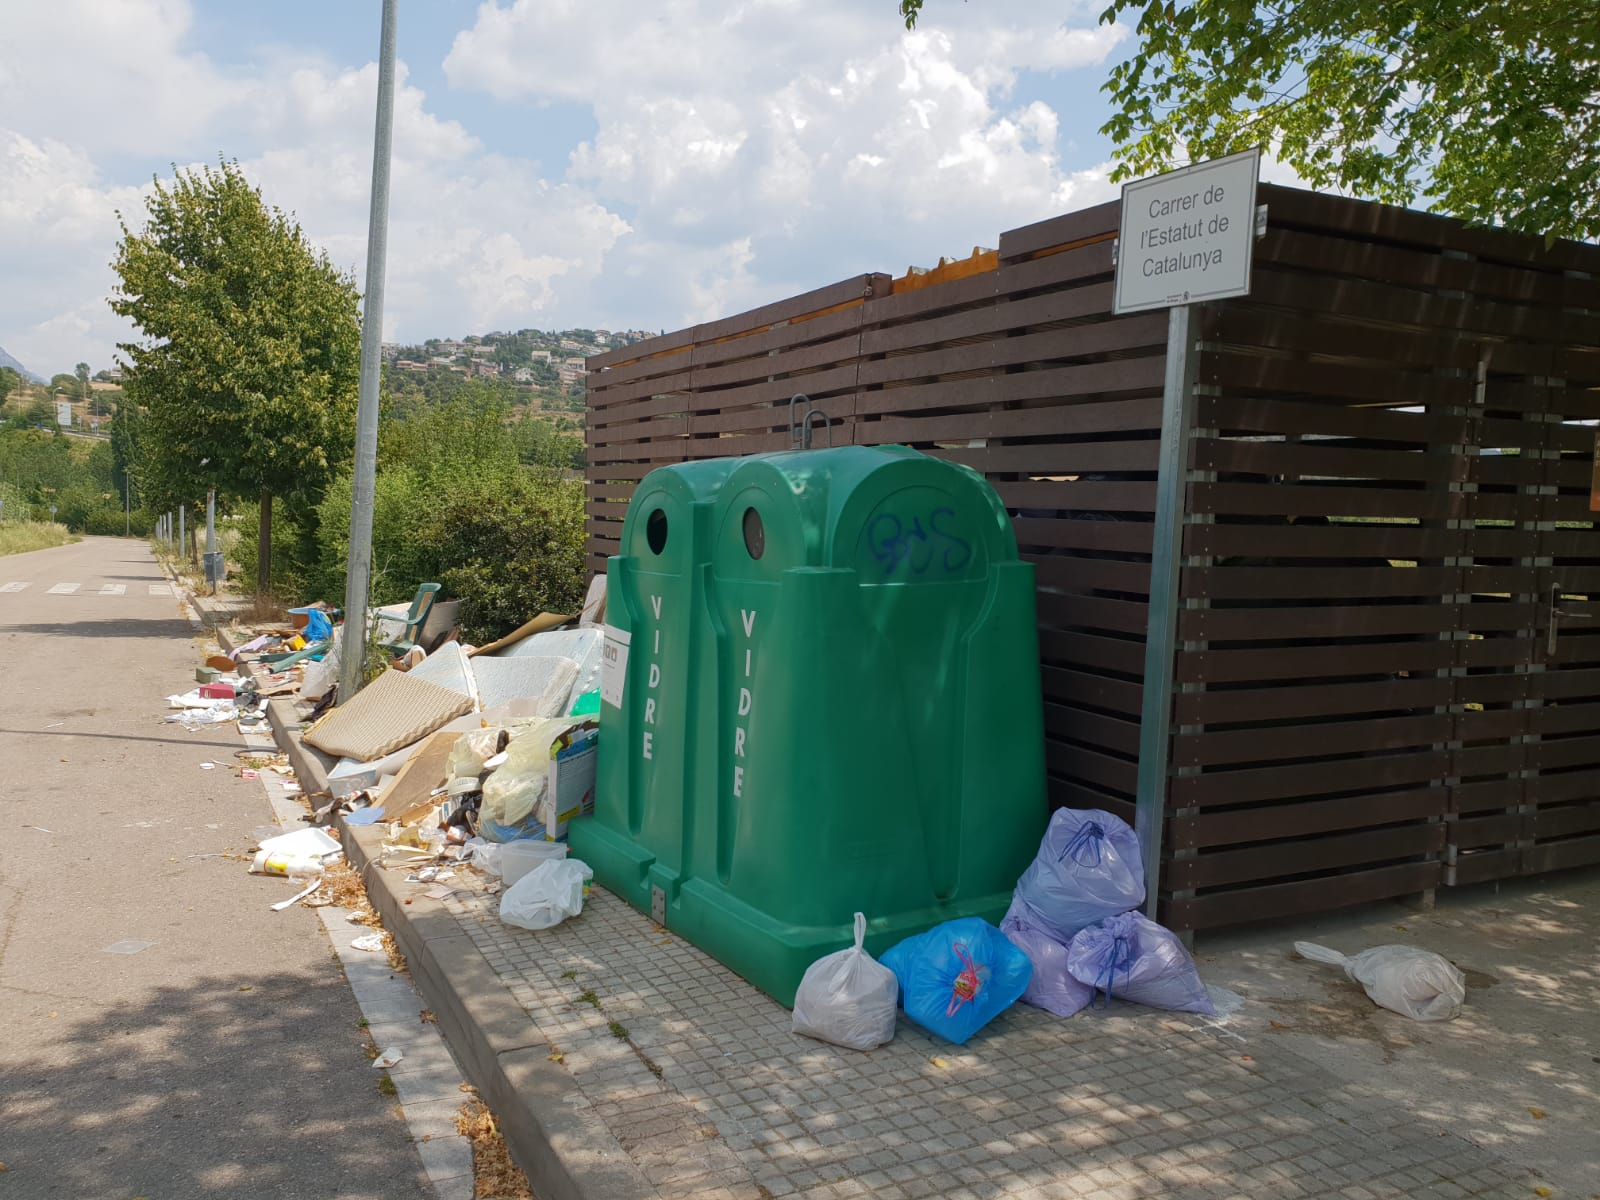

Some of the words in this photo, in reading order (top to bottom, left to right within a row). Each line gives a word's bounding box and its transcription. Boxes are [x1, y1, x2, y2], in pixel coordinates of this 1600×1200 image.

[1149, 192, 1199, 219] Carrer
[1203, 184, 1225, 206] de
[1140, 218, 1203, 250] l'Estatut
[1208, 214, 1230, 235] de
[1142, 248, 1223, 277] Catalunya
[643, 594, 662, 760] VIDRE
[733, 609, 757, 798] VIDRE
